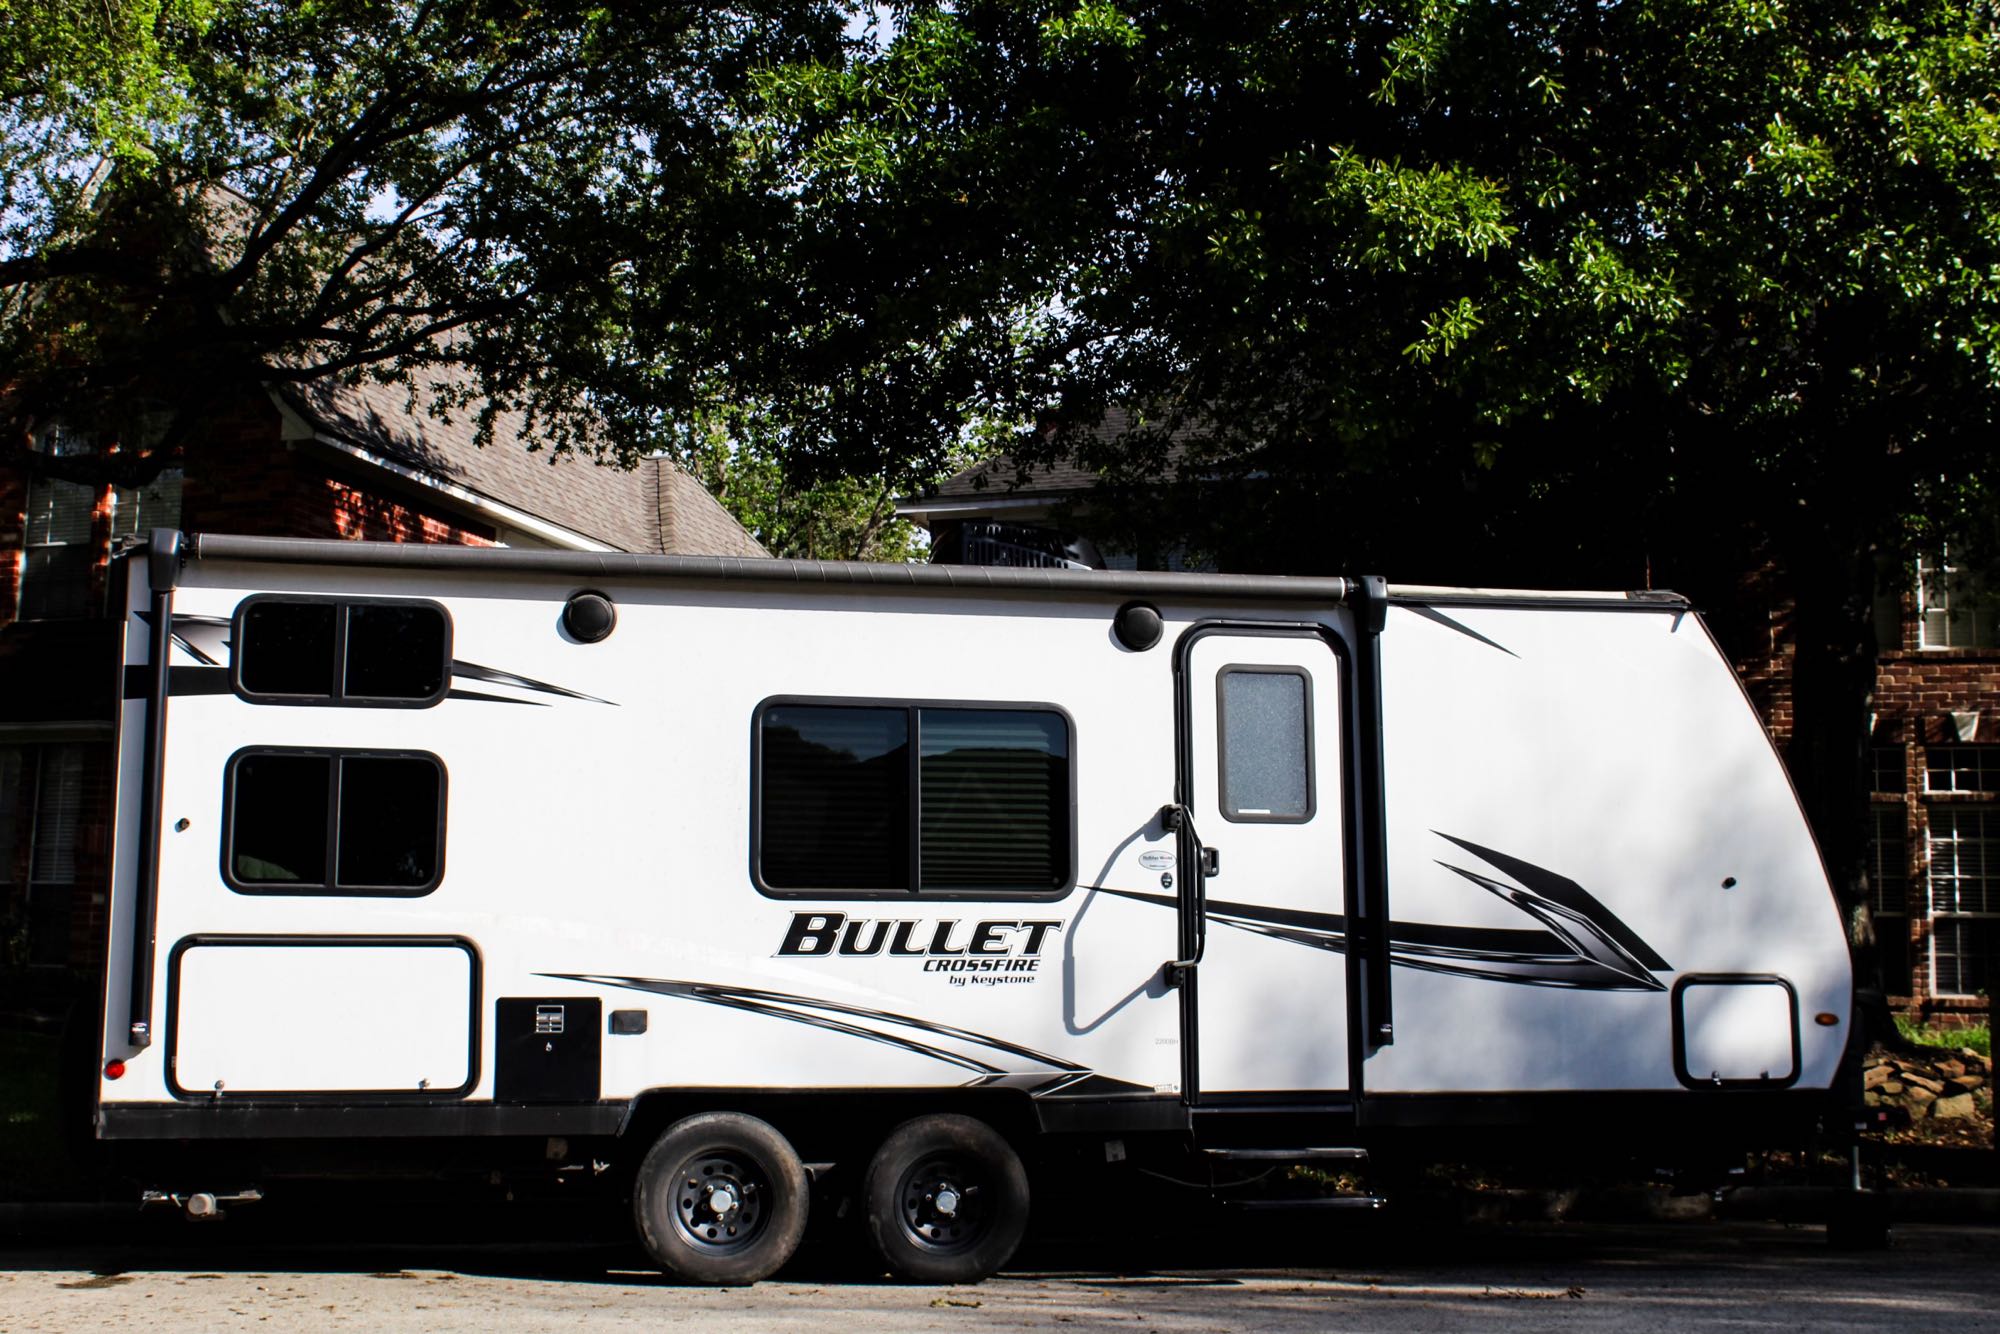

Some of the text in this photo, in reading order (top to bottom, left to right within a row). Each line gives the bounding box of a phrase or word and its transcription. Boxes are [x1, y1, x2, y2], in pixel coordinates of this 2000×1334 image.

[770, 910, 1065, 958] BULLET
[923, 959, 1041, 972] CROSSFIRE
[949, 975, 1035, 987] by Keystone
